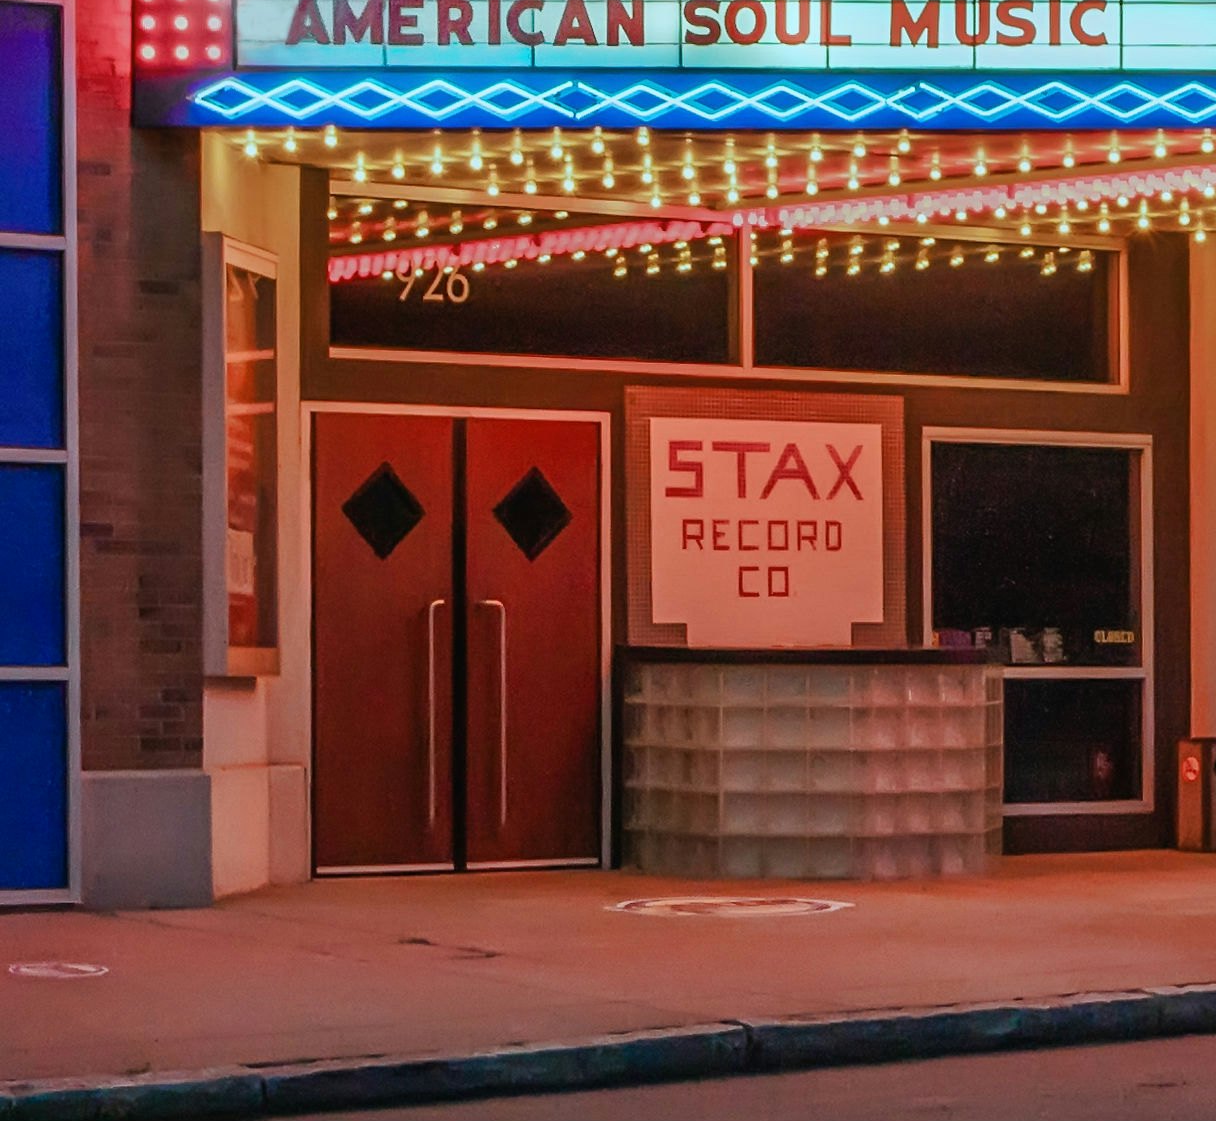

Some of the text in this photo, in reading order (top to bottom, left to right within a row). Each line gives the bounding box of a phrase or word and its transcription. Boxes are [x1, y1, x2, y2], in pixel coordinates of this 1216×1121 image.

[395, 257, 470, 303] 926
[665, 440, 864, 500] STAX
[681, 518, 843, 552] RECORD
[738, 565, 790, 598] CO
